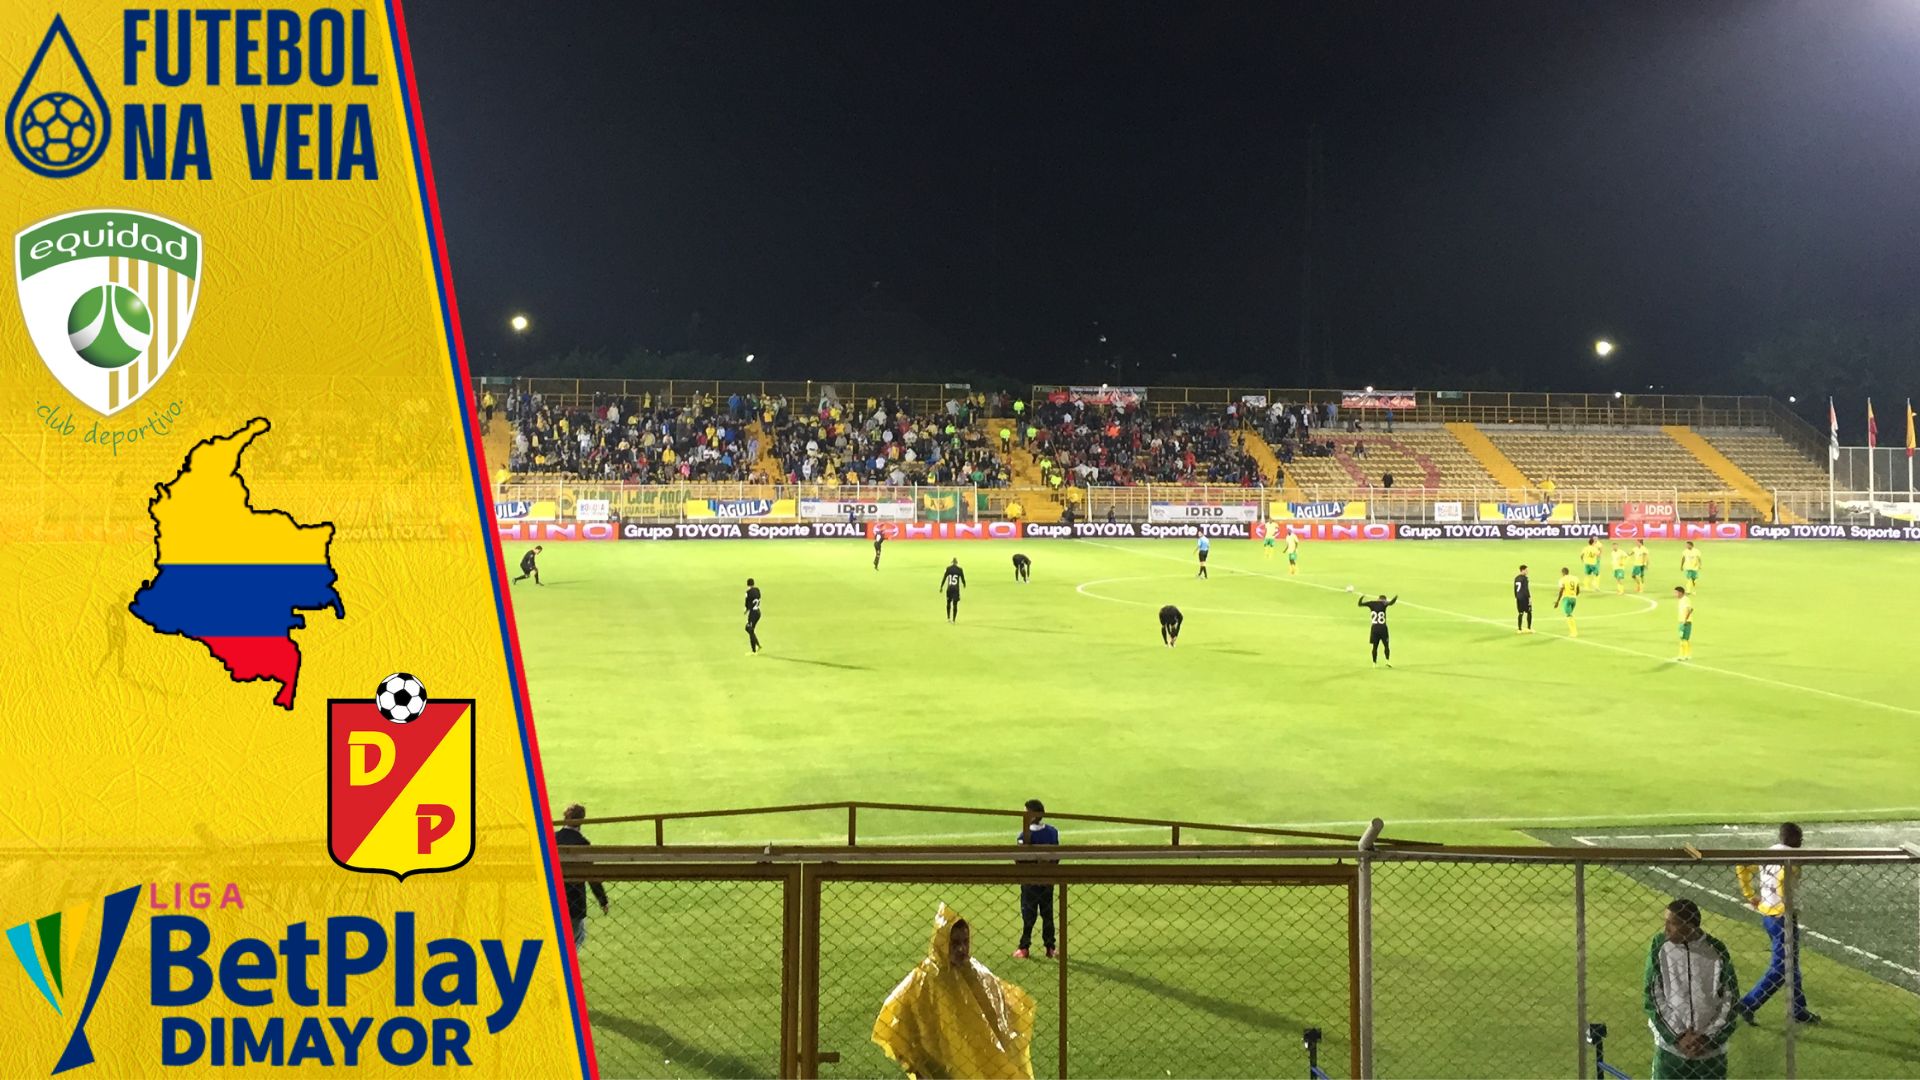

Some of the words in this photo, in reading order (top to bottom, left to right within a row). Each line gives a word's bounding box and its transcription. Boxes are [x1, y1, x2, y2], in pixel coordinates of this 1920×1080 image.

[718, 500, 770, 518] AGUILA
[837, 504, 878, 514] IDRD
[1185, 507, 1224, 516] IDRD
[1295, 502, 1342, 518] AGUILA
[1506, 504, 1551, 520] AGUILA
[1645, 504, 1673, 515] IDRD
[624, 524, 673, 540] Grupo
[676, 524, 742, 537] TOYOTA
[748, 524, 810, 539] Soporte
[813, 523, 865, 537] TOTAL
[905, 523, 1017, 539] HINO
[1027, 524, 1071, 538] Grupo
[1074, 523, 1135, 536] TOYOTA
[1141, 524, 1198, 539] Soporte
[1201, 523, 1249, 536] TOTAL
[1286, 524, 1390, 539] HINO
[1400, 525, 1442, 539] Grupo
[1443, 525, 1501, 537] TOYOTA
[1506, 525, 1560, 539] Soporte
[1562, 524, 1608, 536] TOTAL
[1643, 524, 1742, 538] HINO
[1750, 525, 1790, 539] Grupo
[1791, 525, 1845, 537] TOYOTA
[1851, 525, 1901, 540] Soporte
[948, 574, 959, 585] 15
[1515, 582, 1522, 592] 7
[1371, 610, 1386, 625] 28
